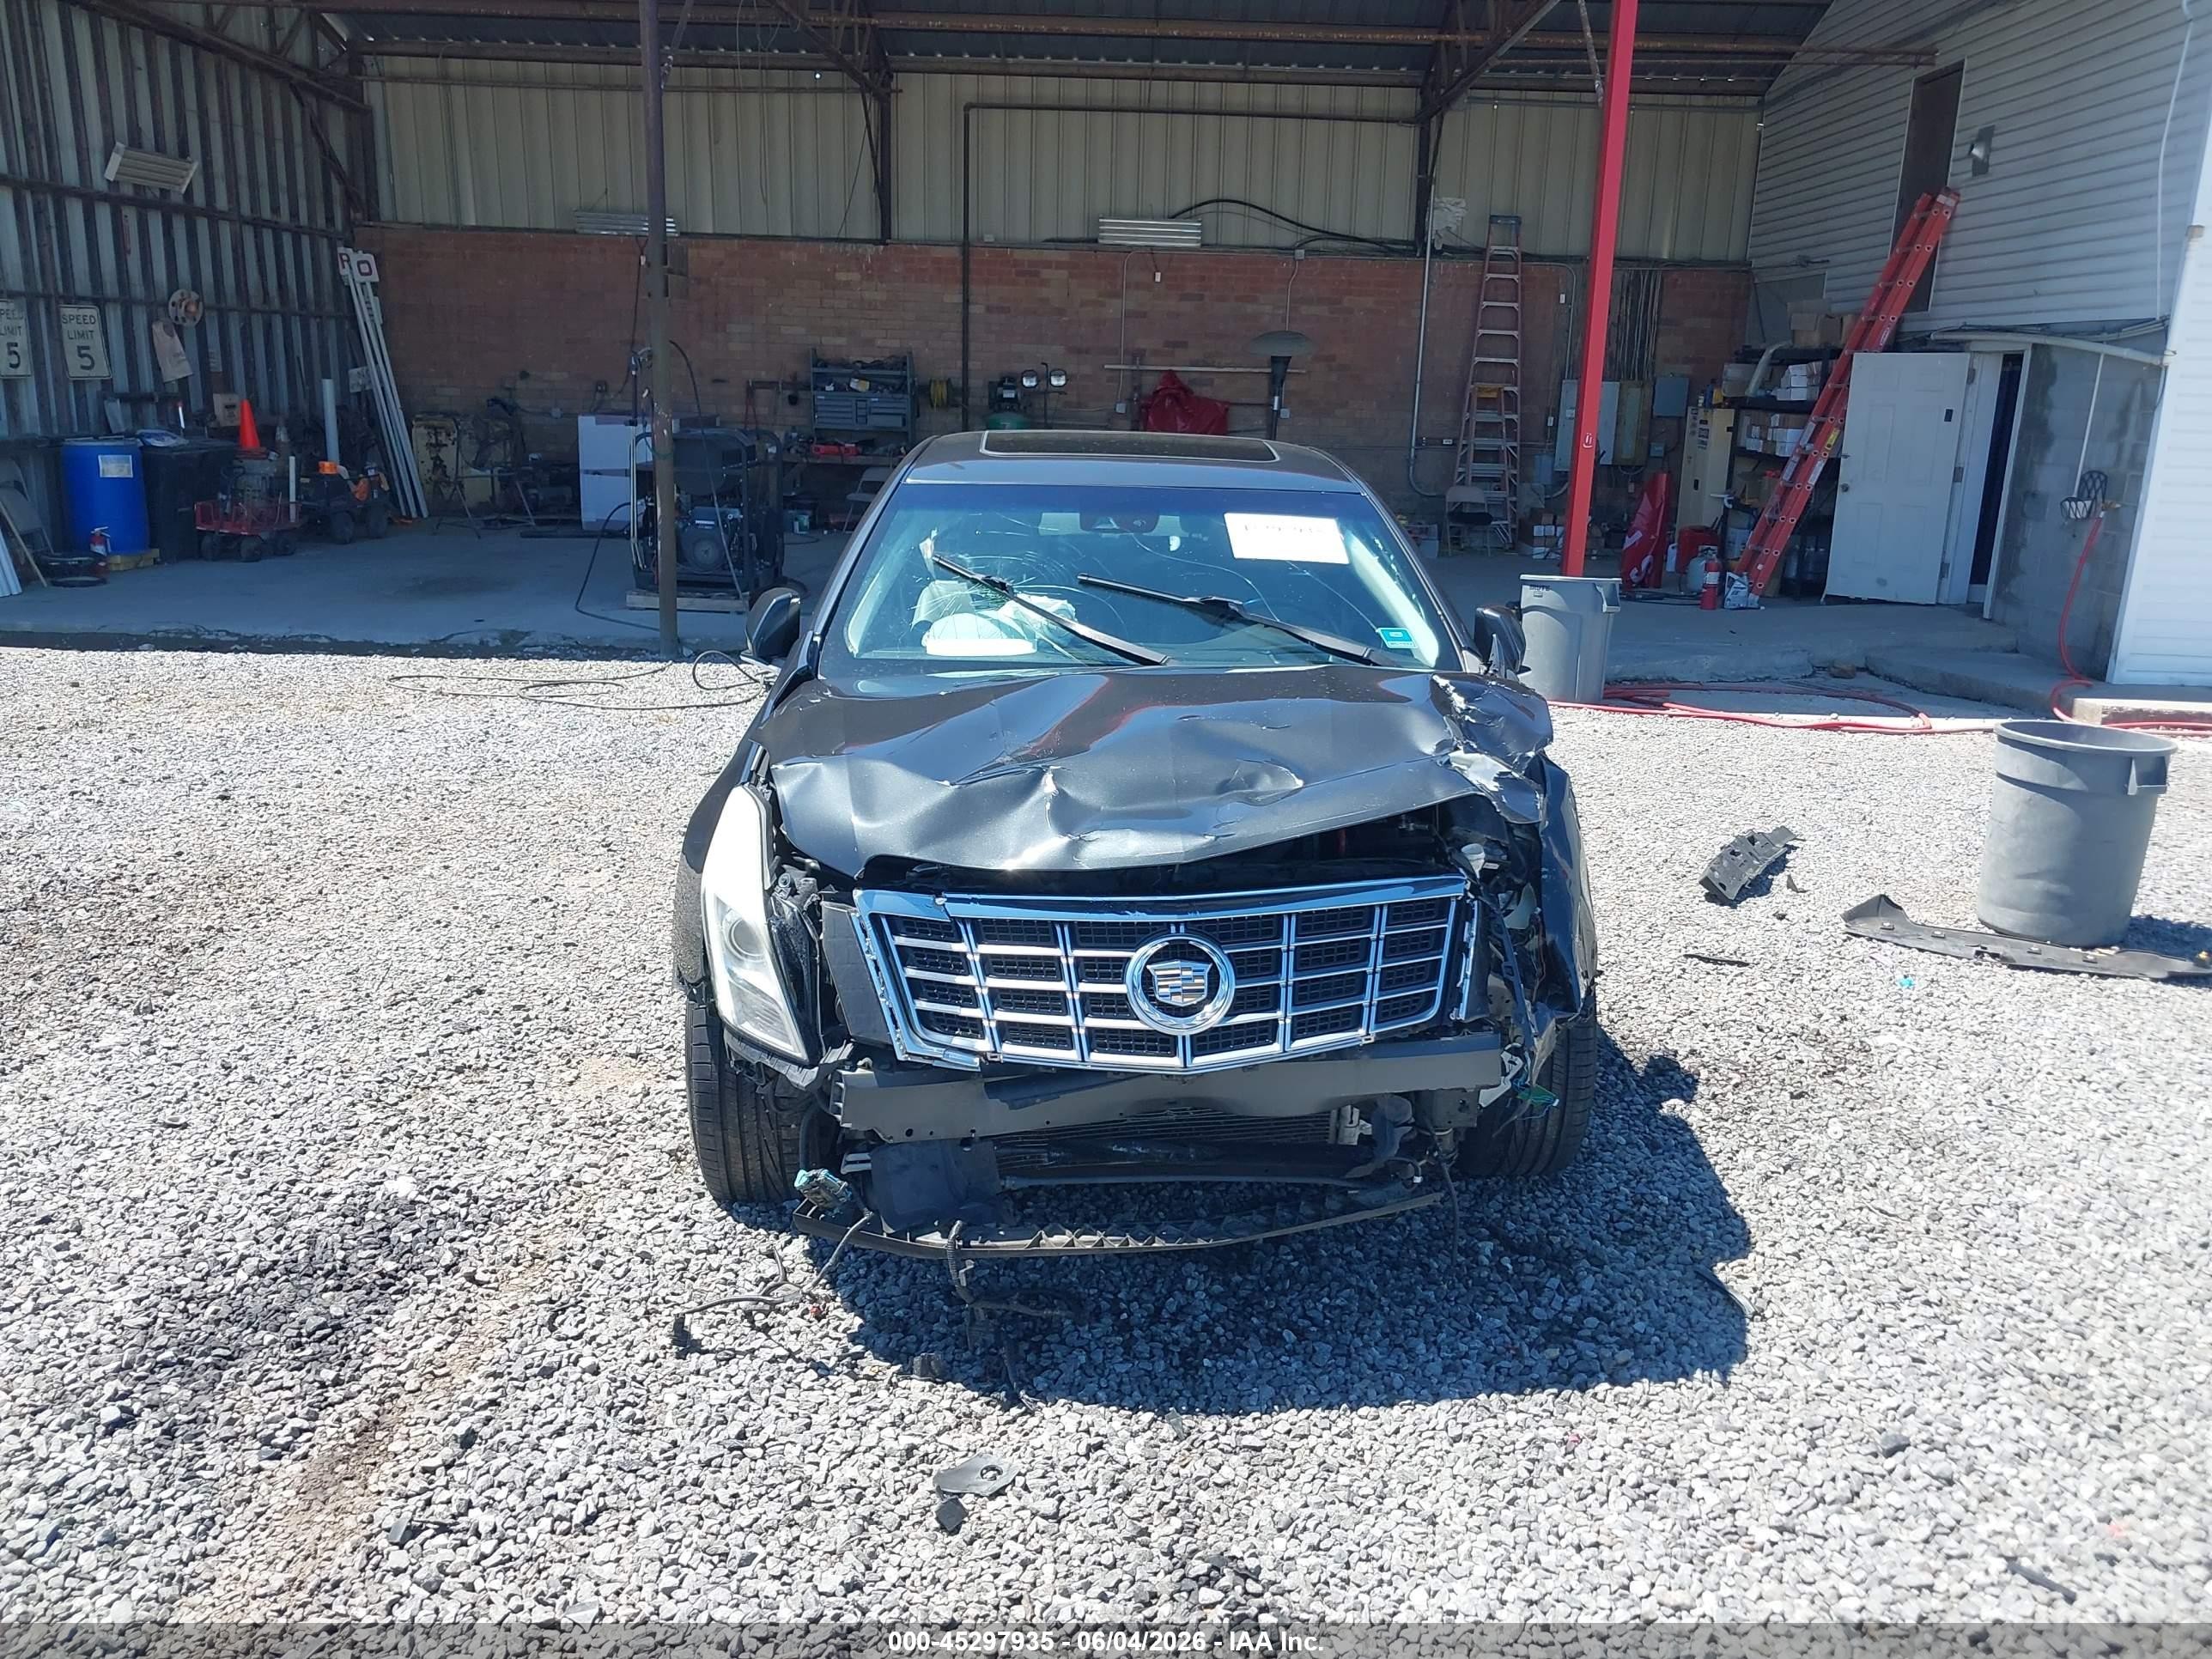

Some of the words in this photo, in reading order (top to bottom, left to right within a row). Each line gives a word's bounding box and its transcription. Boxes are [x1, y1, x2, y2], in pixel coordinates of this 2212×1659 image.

[0, 308, 24, 319] PEED
[61, 313, 97, 325] SPEED
[68, 330, 94, 341] LIMIT
[7, 342, 21, 369] 5
[76, 345, 95, 370] 5
